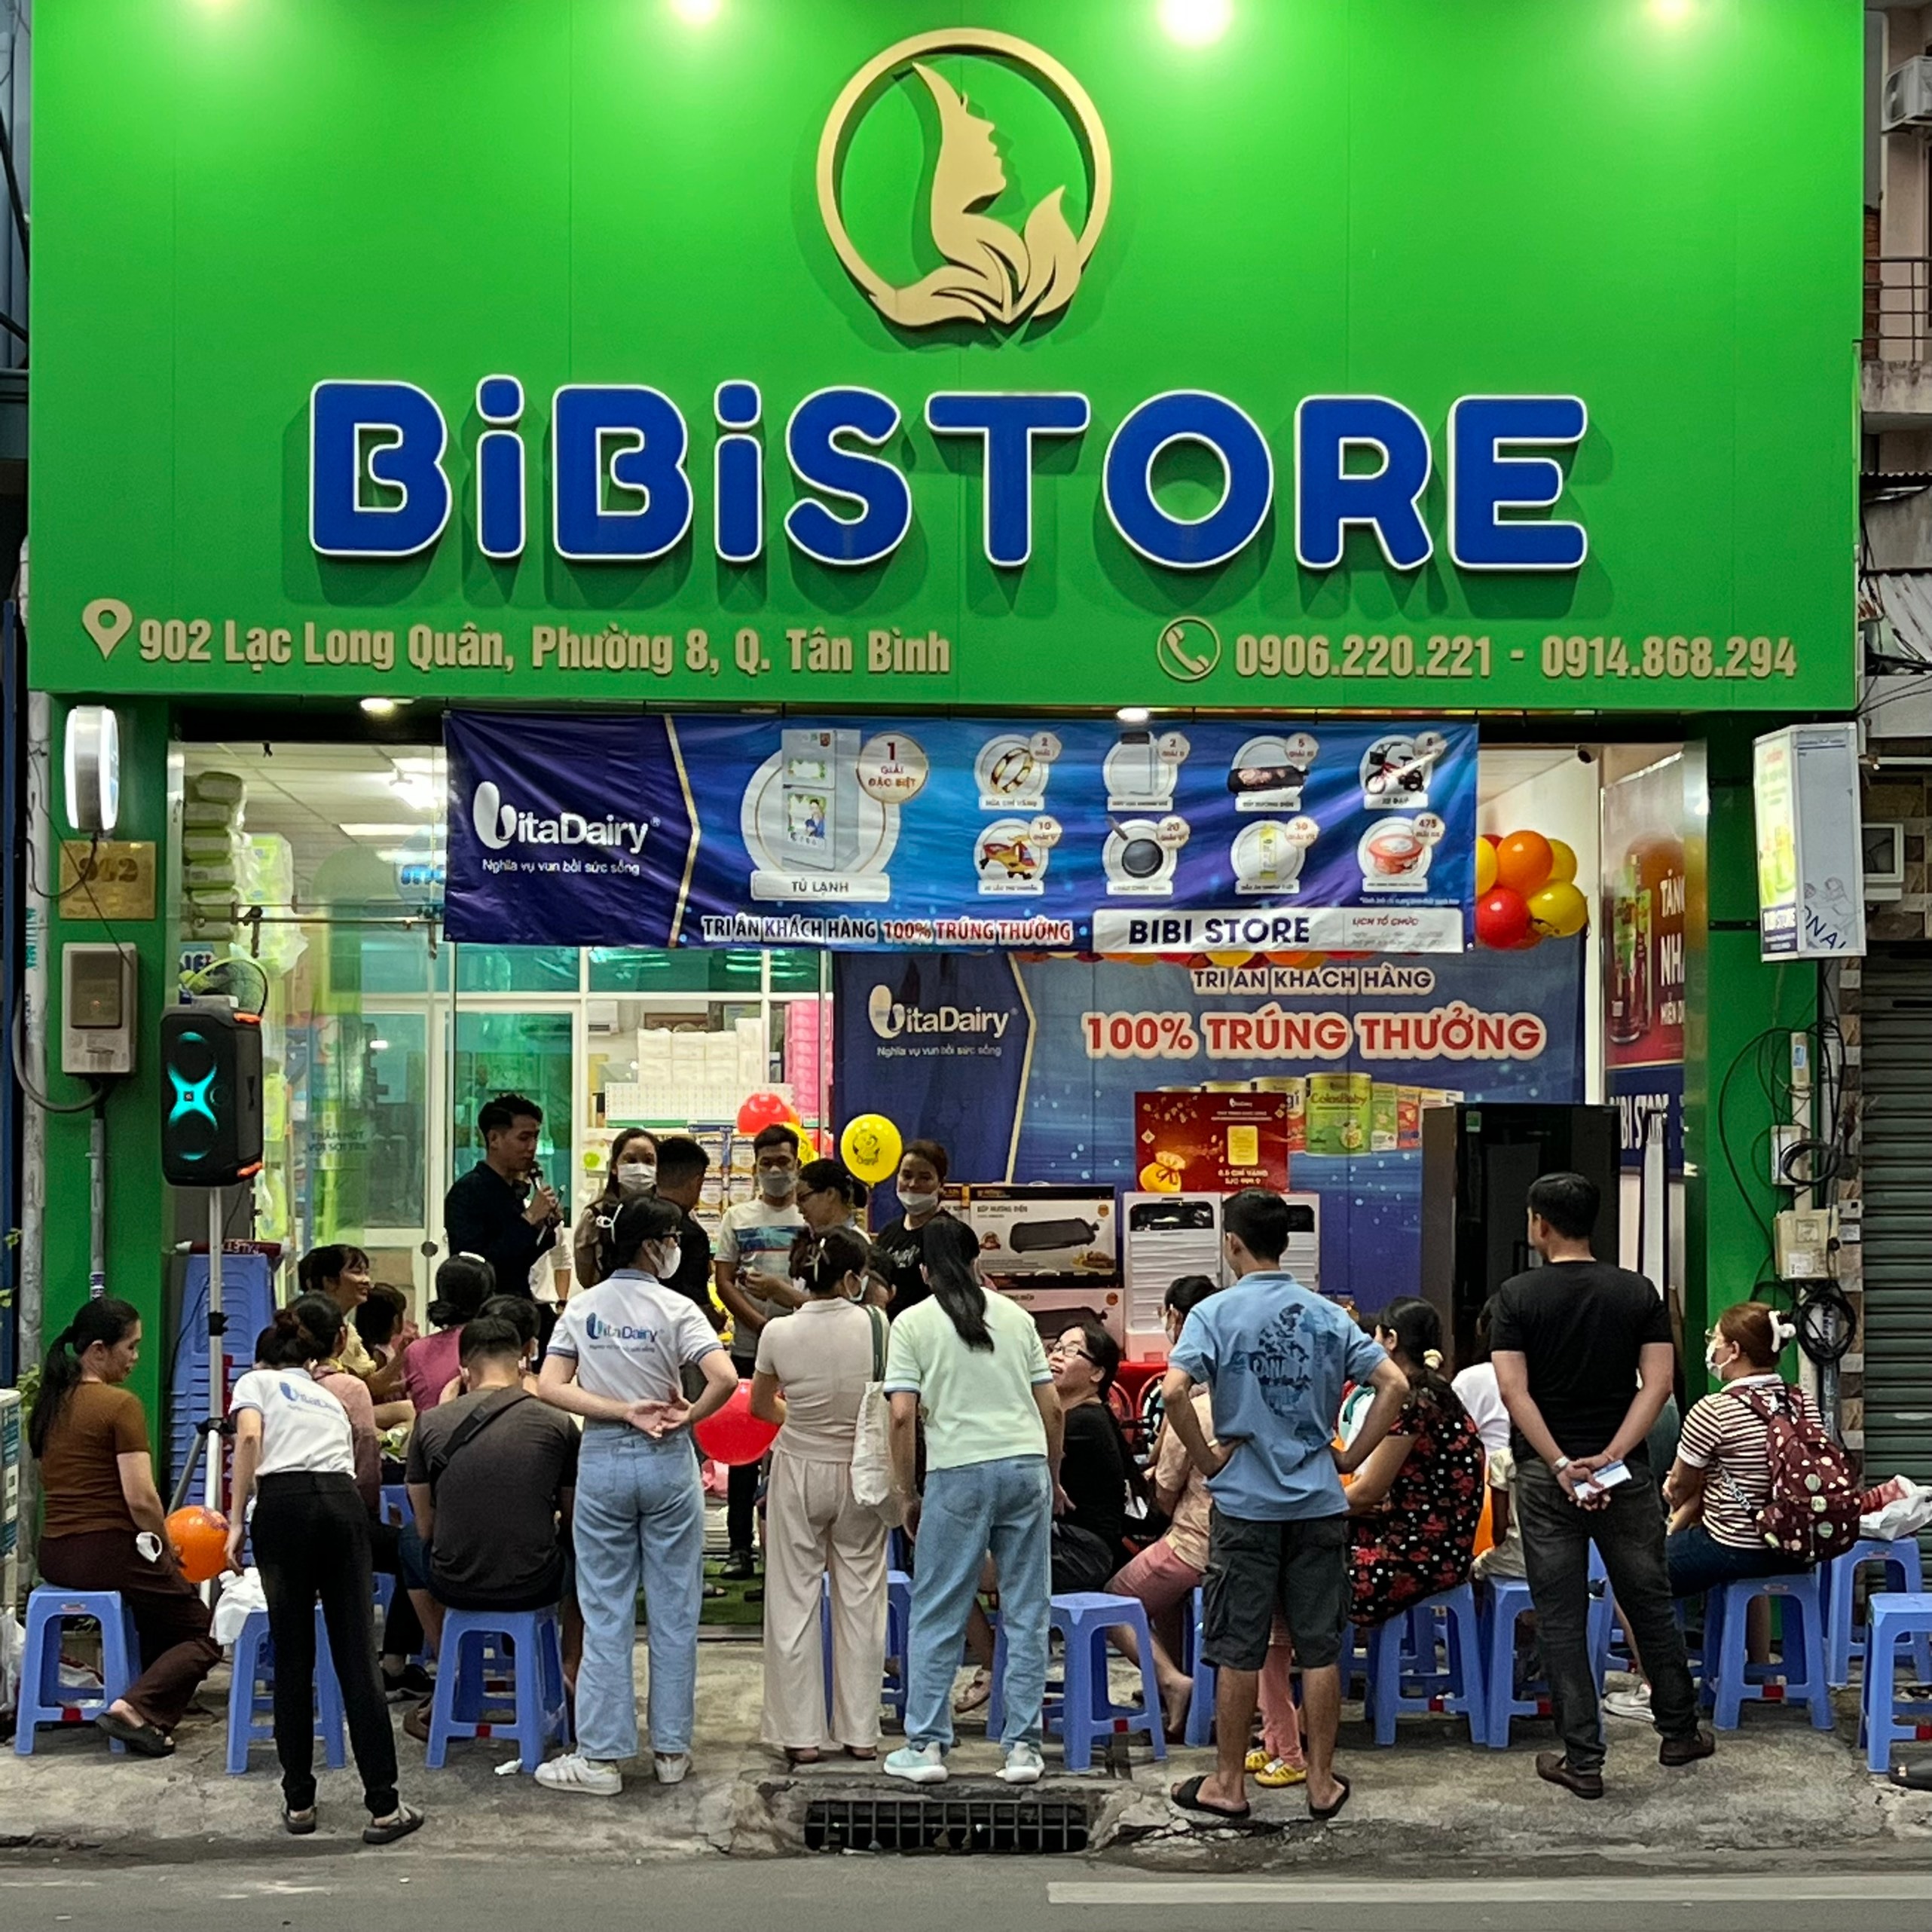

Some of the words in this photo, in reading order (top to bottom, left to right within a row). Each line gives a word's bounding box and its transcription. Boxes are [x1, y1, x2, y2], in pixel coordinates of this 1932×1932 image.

[139, 619, 211, 661] 902
[225, 620, 292, 672] Lạc
[304, 622, 394, 671] Long
[408, 622, 514, 671] Quân,
[532, 622, 673, 674] Phường
[686, 628, 719, 675] 8,
[735, 628, 770, 675] Q.
[786, 626, 851, 672] Tân
[867, 626, 949, 672] Bình
[1235, 634, 1491, 677] 0906.220.221
[1542, 635, 1797, 678] 0914.868.294
[887, 742, 895, 760] 1
[812, 881, 848, 897] LẠNH
[704, 919, 730, 937] TRI
[764, 916, 822, 937] KHÁCH
[828, 916, 876, 940] HÀNG
[884, 924, 931, 940] 100%
[1130, 919, 1193, 945] BIBI
[1205, 917, 1310, 943] STORE
[1194, 971, 1224, 988] TRI
[1363, 961, 1432, 989] HÀNG
[1087, 1018, 1193, 1051] 100%
[1206, 1008, 1347, 1051] TRÚNG
[1360, 1007, 1541, 1051] THƯỞNG
